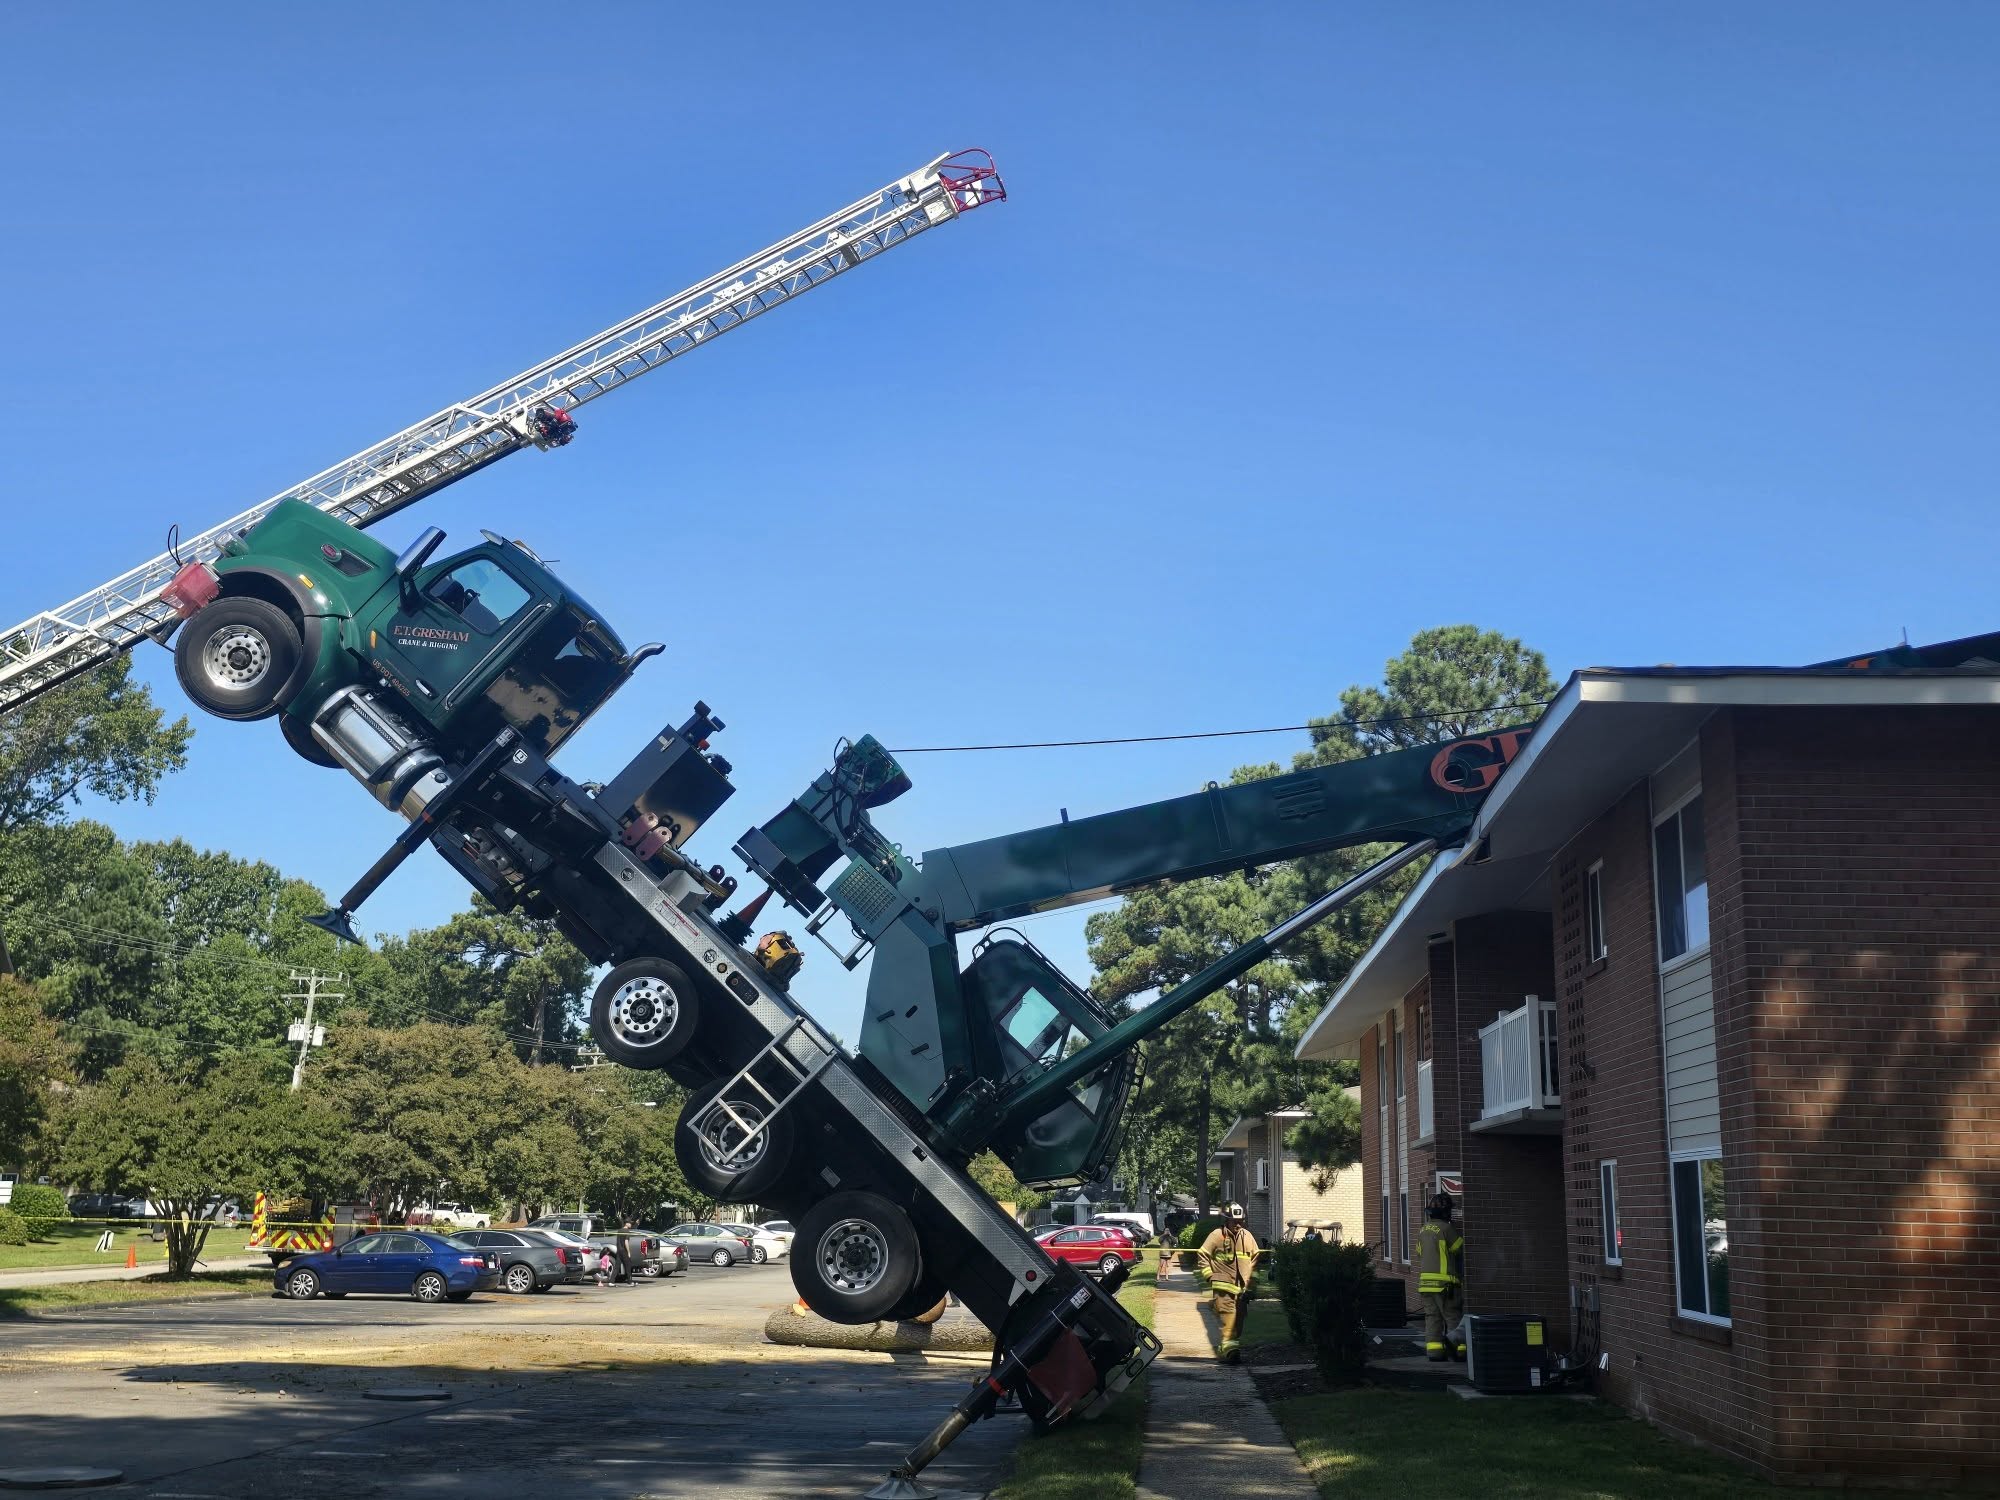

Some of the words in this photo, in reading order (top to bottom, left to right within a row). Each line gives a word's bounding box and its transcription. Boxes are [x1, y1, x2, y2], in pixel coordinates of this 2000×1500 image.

[411, 626, 469, 642] GRESHAM
[398, 638, 421, 647] CRANE
[428, 642, 459, 650] RIGGING
[372, 658, 382, 669] US
[380, 666, 394, 679] DOT
